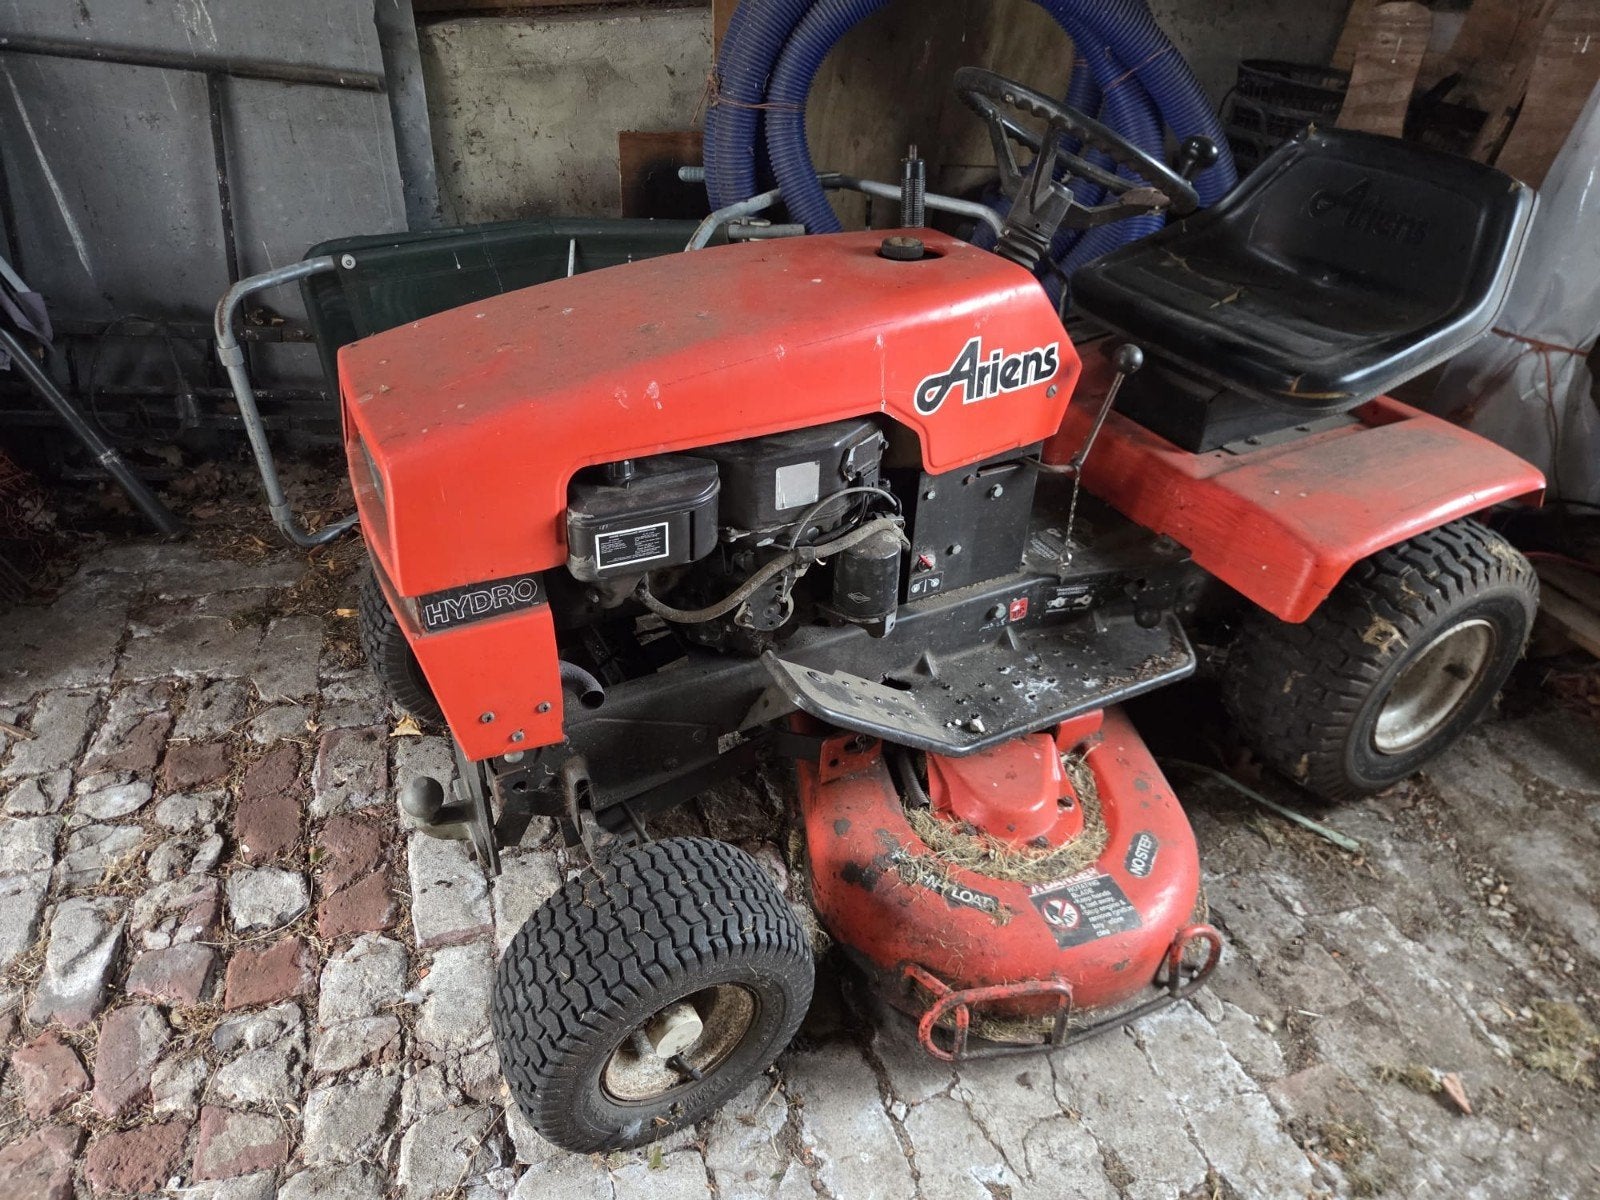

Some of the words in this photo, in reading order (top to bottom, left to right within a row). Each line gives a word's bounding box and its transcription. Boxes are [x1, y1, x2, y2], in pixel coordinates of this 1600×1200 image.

[1308, 178, 1430, 243] Ariens
[914, 336, 1059, 415] Ariens
[425, 578, 538, 626] HYDRO
[1130, 858, 1146, 876] NO
[1134, 834, 1153, 860] STEP
